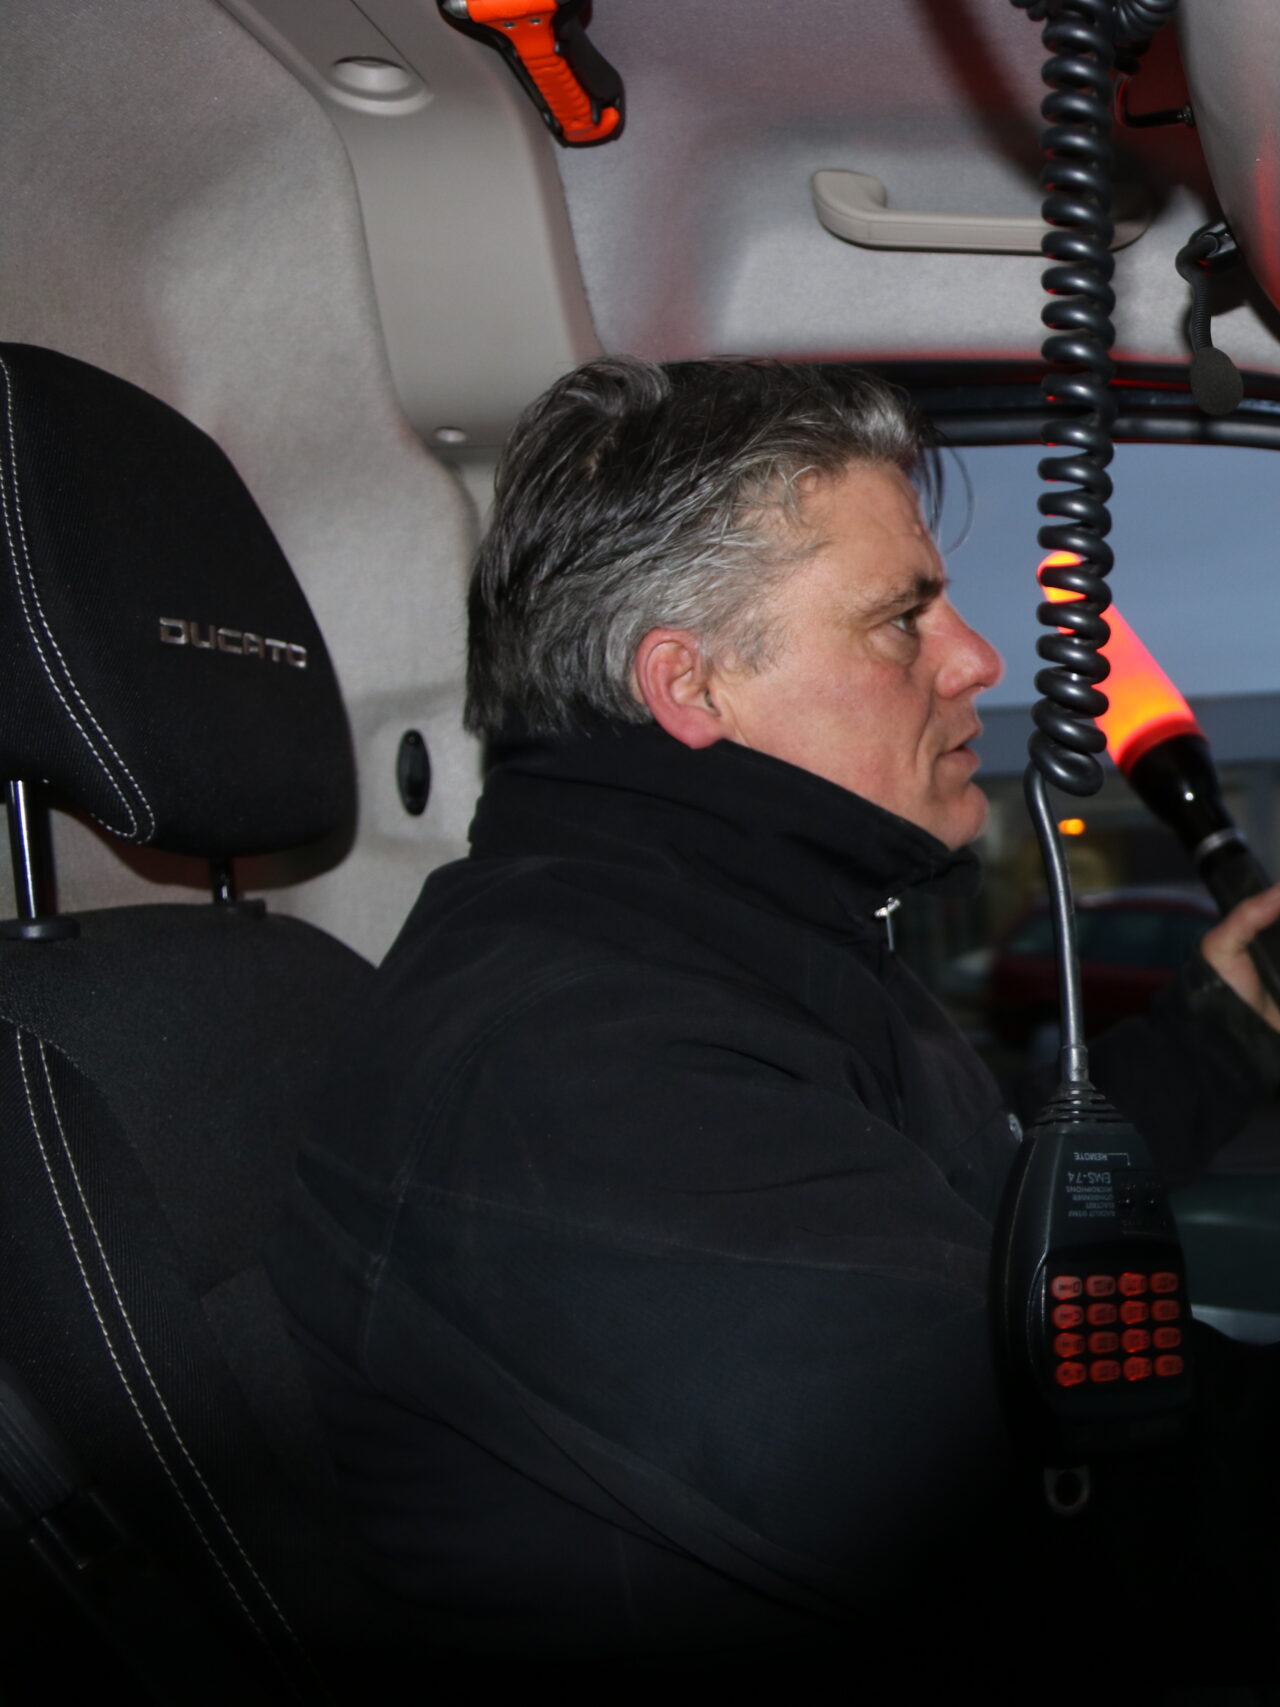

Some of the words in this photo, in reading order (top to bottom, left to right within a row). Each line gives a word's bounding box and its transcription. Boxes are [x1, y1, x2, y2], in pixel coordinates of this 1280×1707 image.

[159, 617, 307, 668] DUCATO
[1073, 1152, 1108, 1161] REMOTE
[1067, 1171, 1112, 1184] EMS-74
